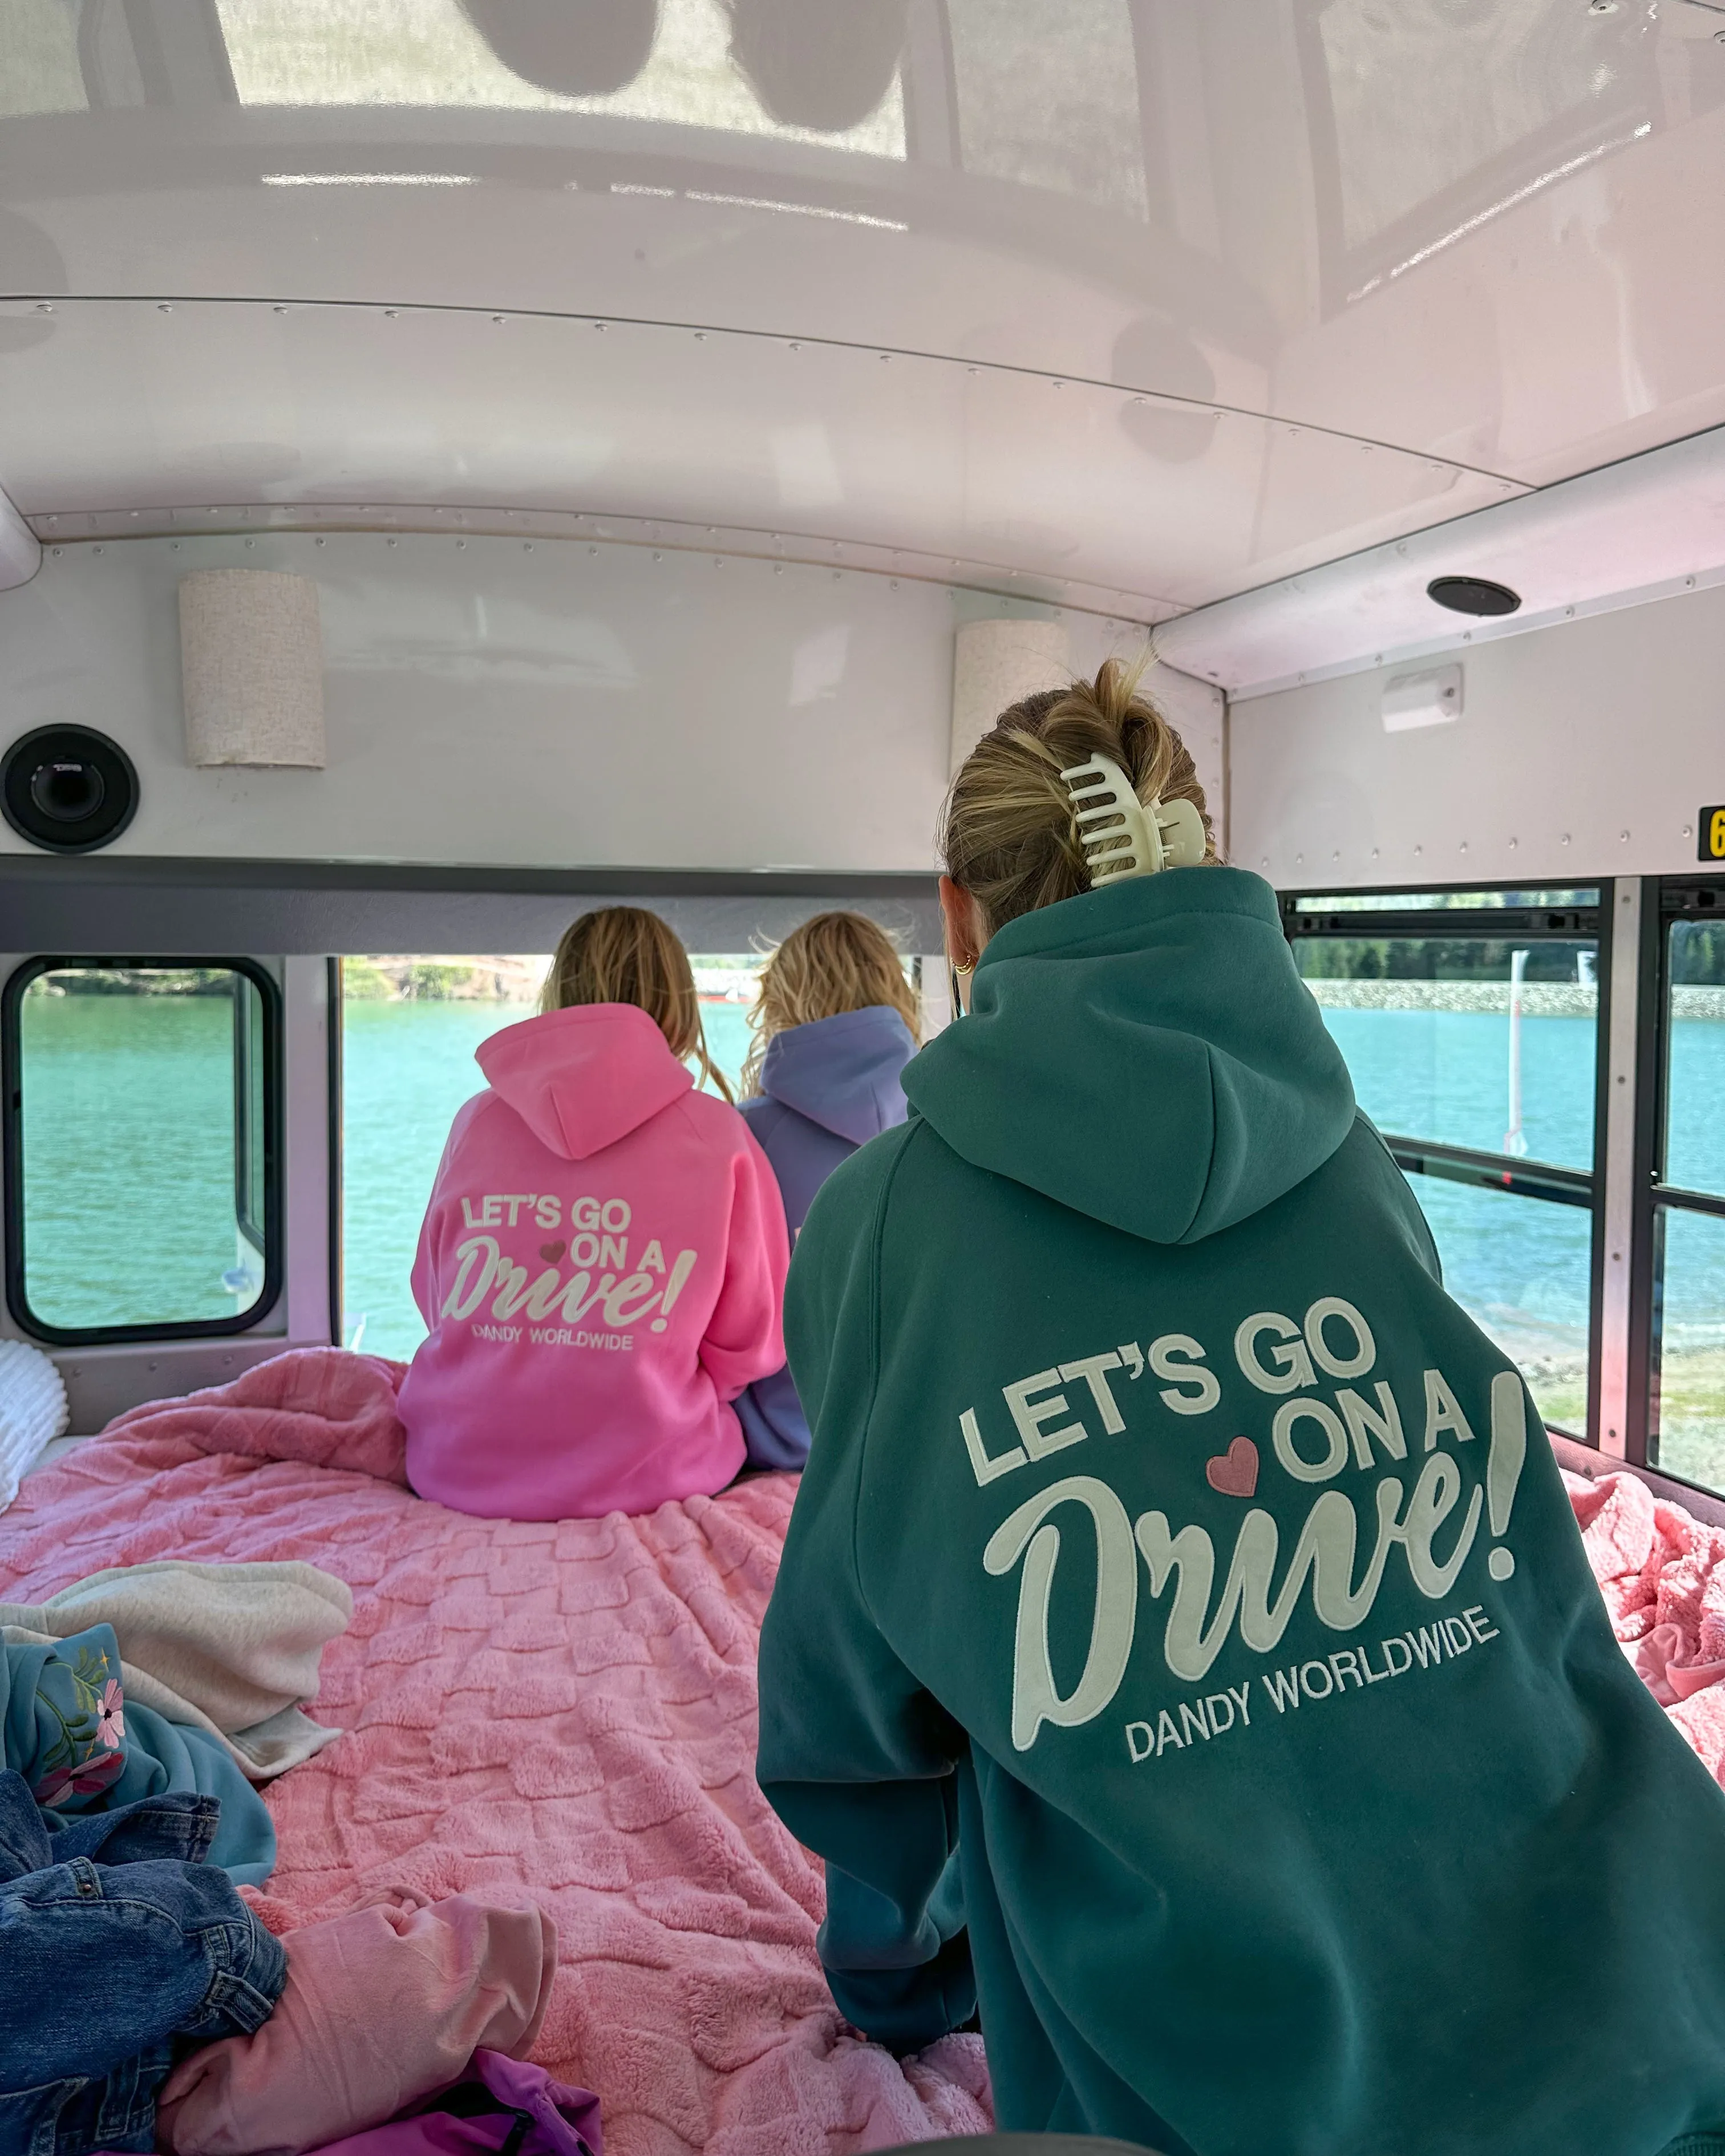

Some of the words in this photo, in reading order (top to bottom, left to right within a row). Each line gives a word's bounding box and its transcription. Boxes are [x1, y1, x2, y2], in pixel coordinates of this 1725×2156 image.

[461, 1194, 562, 1229] LET'S
[571, 1197, 631, 1233] GO
[570, 1232, 628, 1270] ON
[637, 1240, 666, 1273] A
[441, 1235, 698, 1334] Drive!
[471, 1324, 523, 1343] DANDY
[529, 1327, 634, 1350] WORLDWIDE
[1234, 1296, 1376, 1394] GO
[1272, 1381, 1407, 1482] ON
[1424, 1369, 1476, 1452] A
[983, 1371, 1527, 1752] Drive!
[1125, 1682, 1252, 1764] DANDY
[1262, 1605, 1500, 1713] WORLDWIDE
